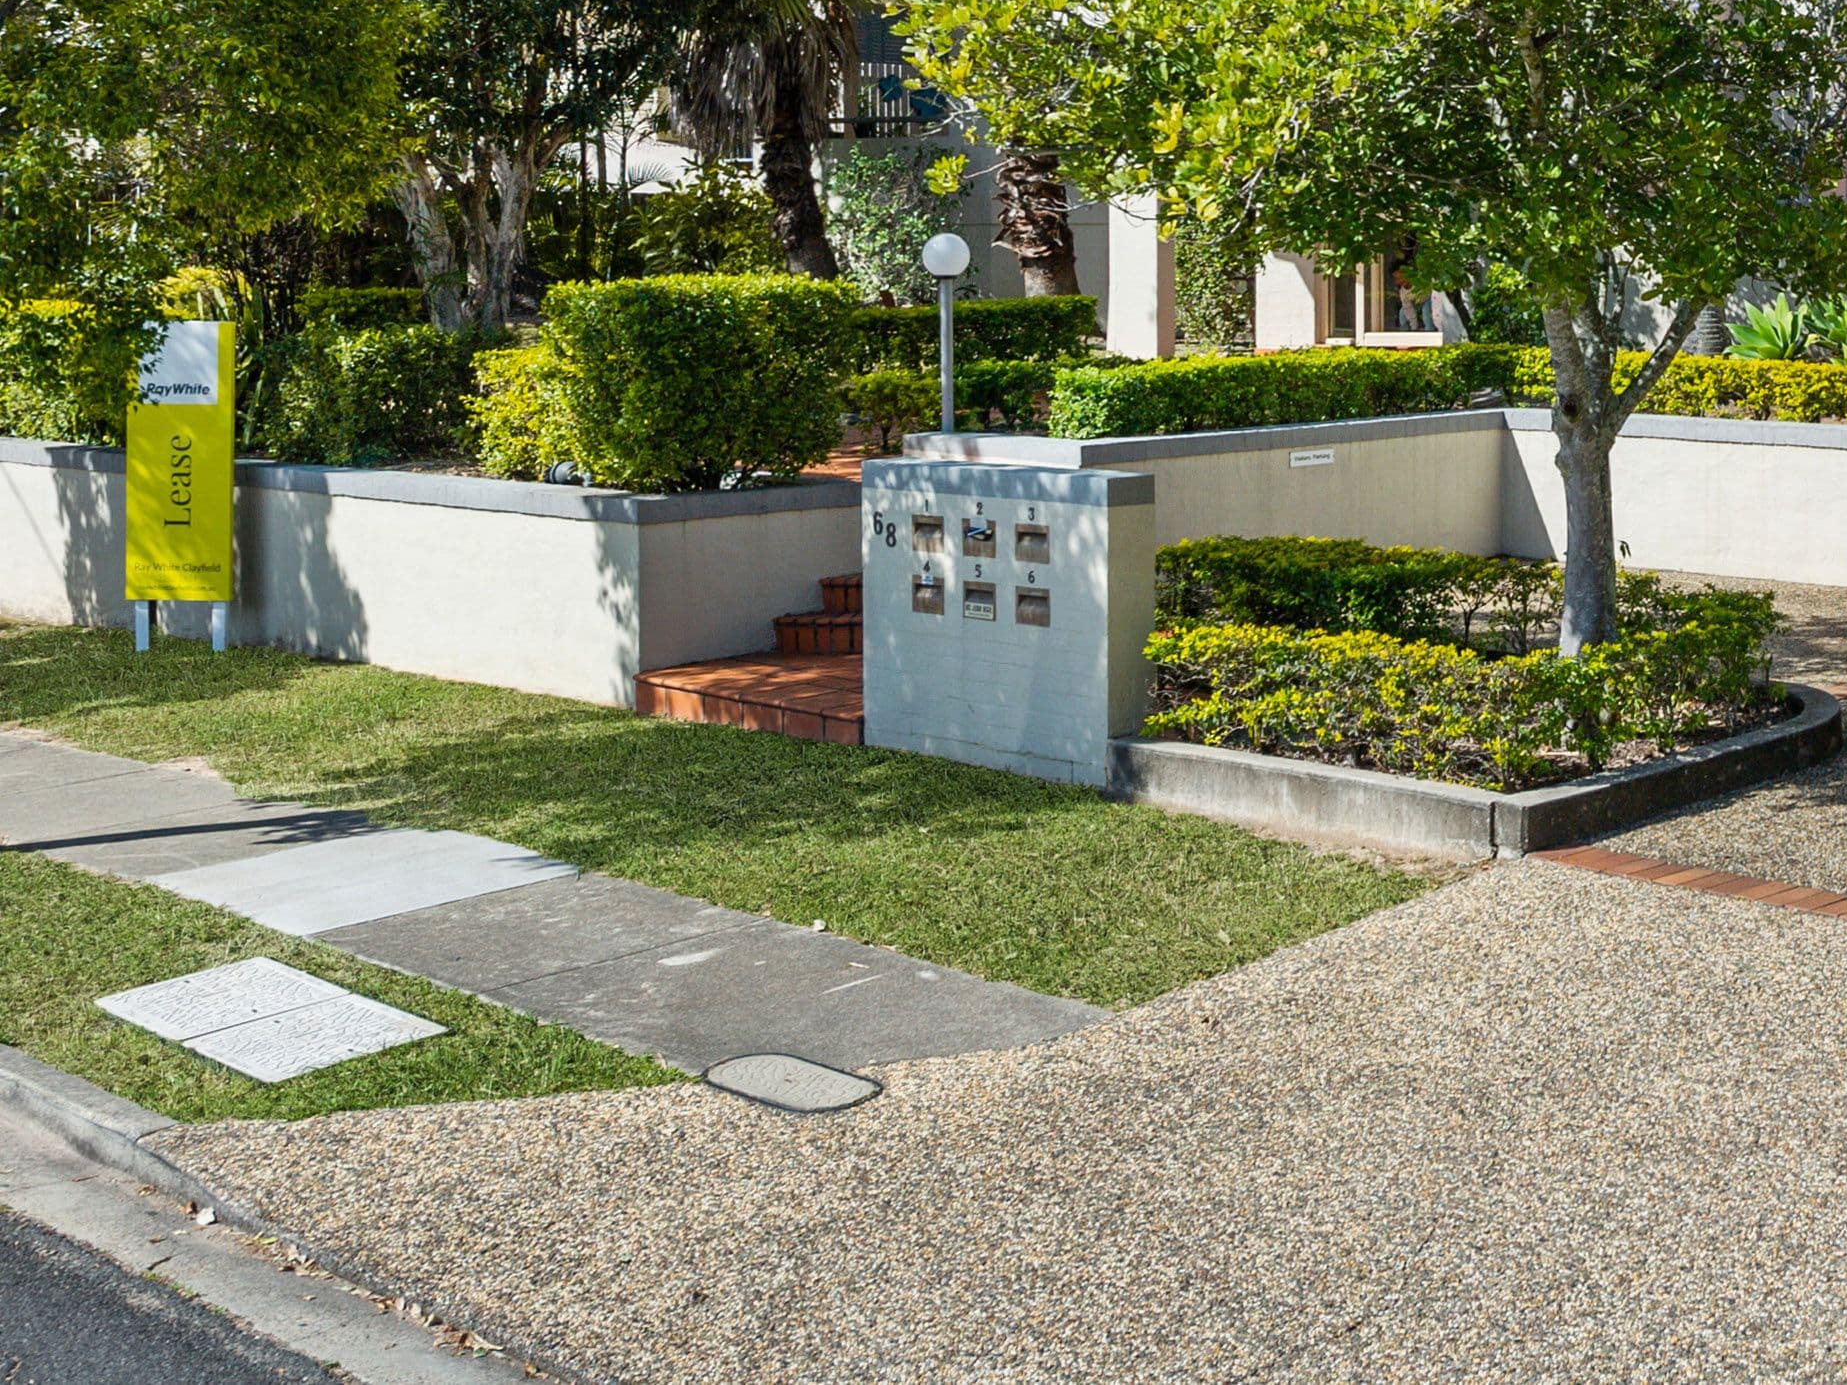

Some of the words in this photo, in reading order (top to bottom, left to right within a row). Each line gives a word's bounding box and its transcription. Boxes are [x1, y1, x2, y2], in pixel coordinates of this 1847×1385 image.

[164, 434, 192, 529] Lease
[924, 499, 929, 512] 1
[976, 501, 984, 516] 2
[1027, 507, 1036, 522] 3
[873, 511, 897, 548] 68
[182, 561, 222, 574] Clayfield
[922, 560, 931, 573] 4
[974, 564, 983, 578] 5
[1027, 569, 1036, 584] 6
